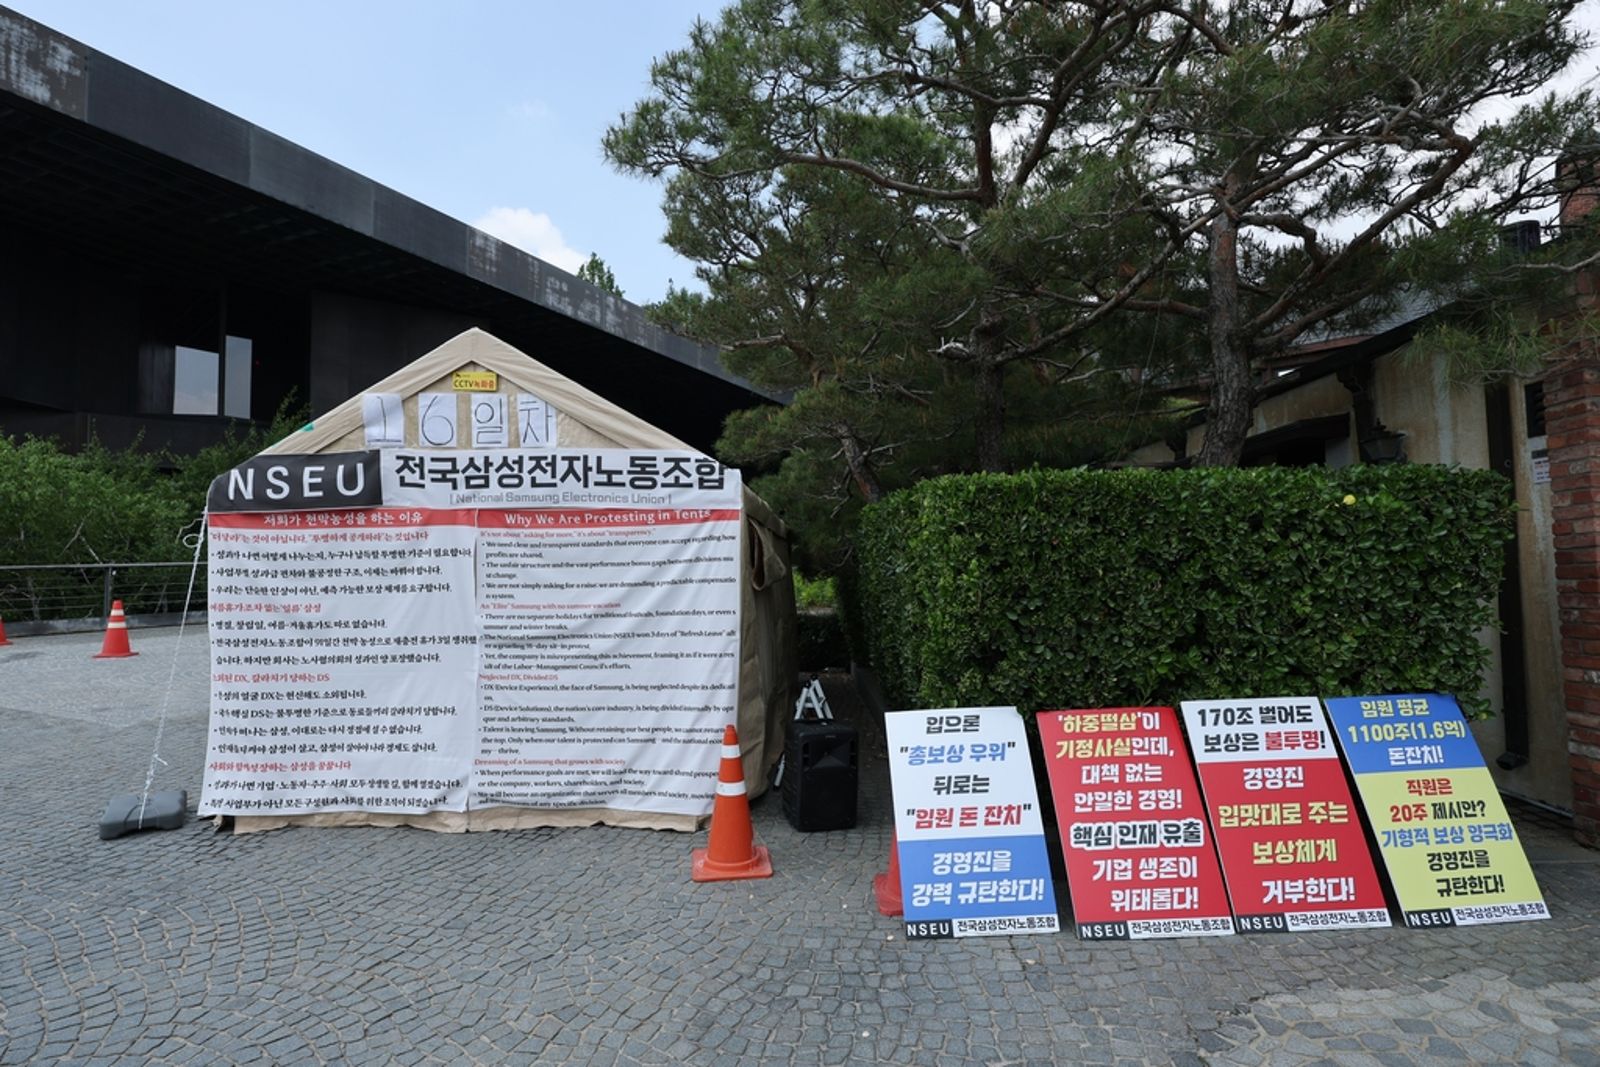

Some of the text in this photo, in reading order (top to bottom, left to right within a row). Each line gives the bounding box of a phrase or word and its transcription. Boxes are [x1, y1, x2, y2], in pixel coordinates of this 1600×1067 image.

[227, 462, 364, 500] NSEU
[395, 454, 725, 490] 전국삼성전자노동조합
[506, 492, 560, 505] Samsung
[562, 492, 628, 504] Electronics
[264, 511, 423, 526] 저희가 천막농성을 하는 이유
[504, 514, 532, 527] Why
[535, 514, 554, 524] We
[559, 514, 580, 524] Are
[584, 510, 655, 524] Protesting
[659, 510, 670, 520] in
[1198, 706, 1313, 727] 170조 벌어도
[1360, 699, 1430, 718] 임원 평균
[926, 715, 980, 734] 입으론
[1348, 721, 1466, 743] 1100주(1.6억)
[1056, 737, 1174, 759] 기정사실인데,
[1204, 731, 1326, 753] 보상은 불투명!
[900, 742, 1016, 765] "총보상 우위"
[1388, 746, 1444, 766] 돈잔치!
[1081, 764, 1162, 784] 대책 없는
[1243, 767, 1304, 790] 경영진
[933, 775, 990, 795] 뒤로는
[1406, 778, 1453, 796] 직원은
[1074, 789, 1182, 813] 안일한 경영!
[1390, 801, 1486, 822] 20주 제시안?
[907, 803, 1032, 829] "임원 돈 잔치"
[1218, 801, 1348, 827] 입맛대로 주는
[1072, 822, 1201, 847] 핵심 인재 유출
[1381, 823, 1513, 848] 기형적 보상 양극화
[1253, 839, 1338, 864] 보상체계
[1427, 850, 1490, 871] 경영진을
[932, 850, 1012, 875] 경영진을
[1093, 856, 1198, 881] 기업 생존이
[912, 879, 1044, 907] 강력 규탄한다!
[1262, 878, 1355, 904] 거부한다!
[1436, 875, 1505, 897] 규탄한다!
[1110, 887, 1199, 912] 위태롭다!
[1289, 911, 1386, 926] 전국삼성전자노동조합
[1410, 912, 1450, 926] NSEU
[1456, 902, 1545, 920] 전국삼성전자노동조합
[907, 922, 949, 936] NSEU
[957, 917, 1055, 932] 전국삼성전자노동조합
[1082, 924, 1125, 938] NSEU
[1132, 919, 1230, 934] 전국삼성전자노동조합
[1240, 917, 1283, 930] NSEU
